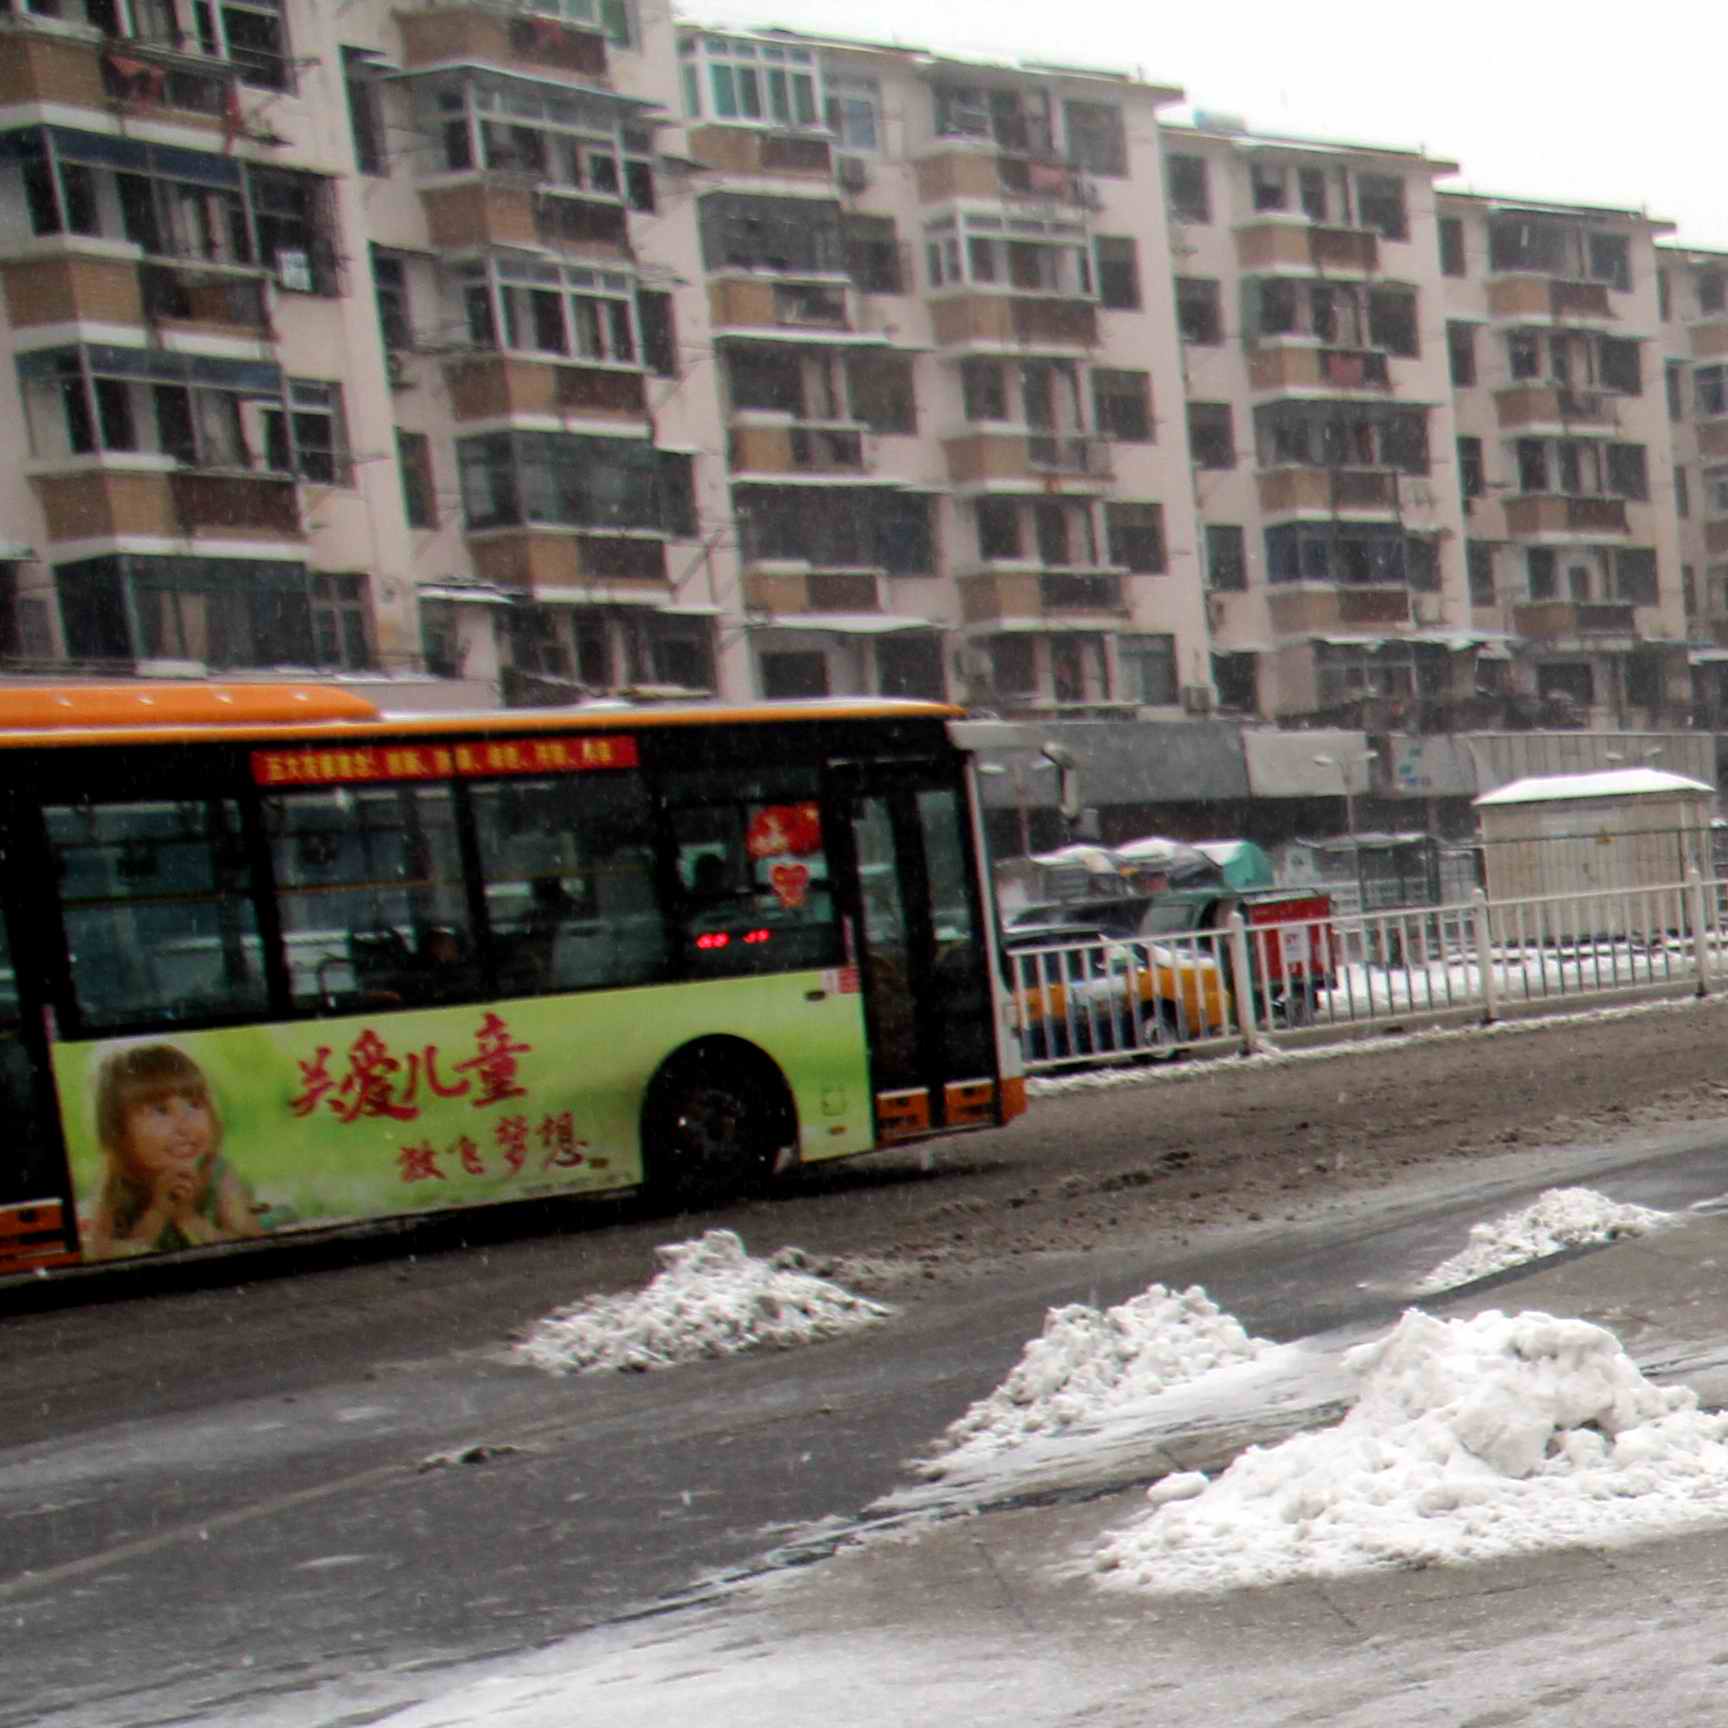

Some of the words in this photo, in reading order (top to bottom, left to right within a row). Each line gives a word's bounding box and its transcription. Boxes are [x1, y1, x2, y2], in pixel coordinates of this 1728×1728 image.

[290, 1012, 531, 1123] 关爱儿童
[399, 1110, 589, 1182] 放飞梦想
